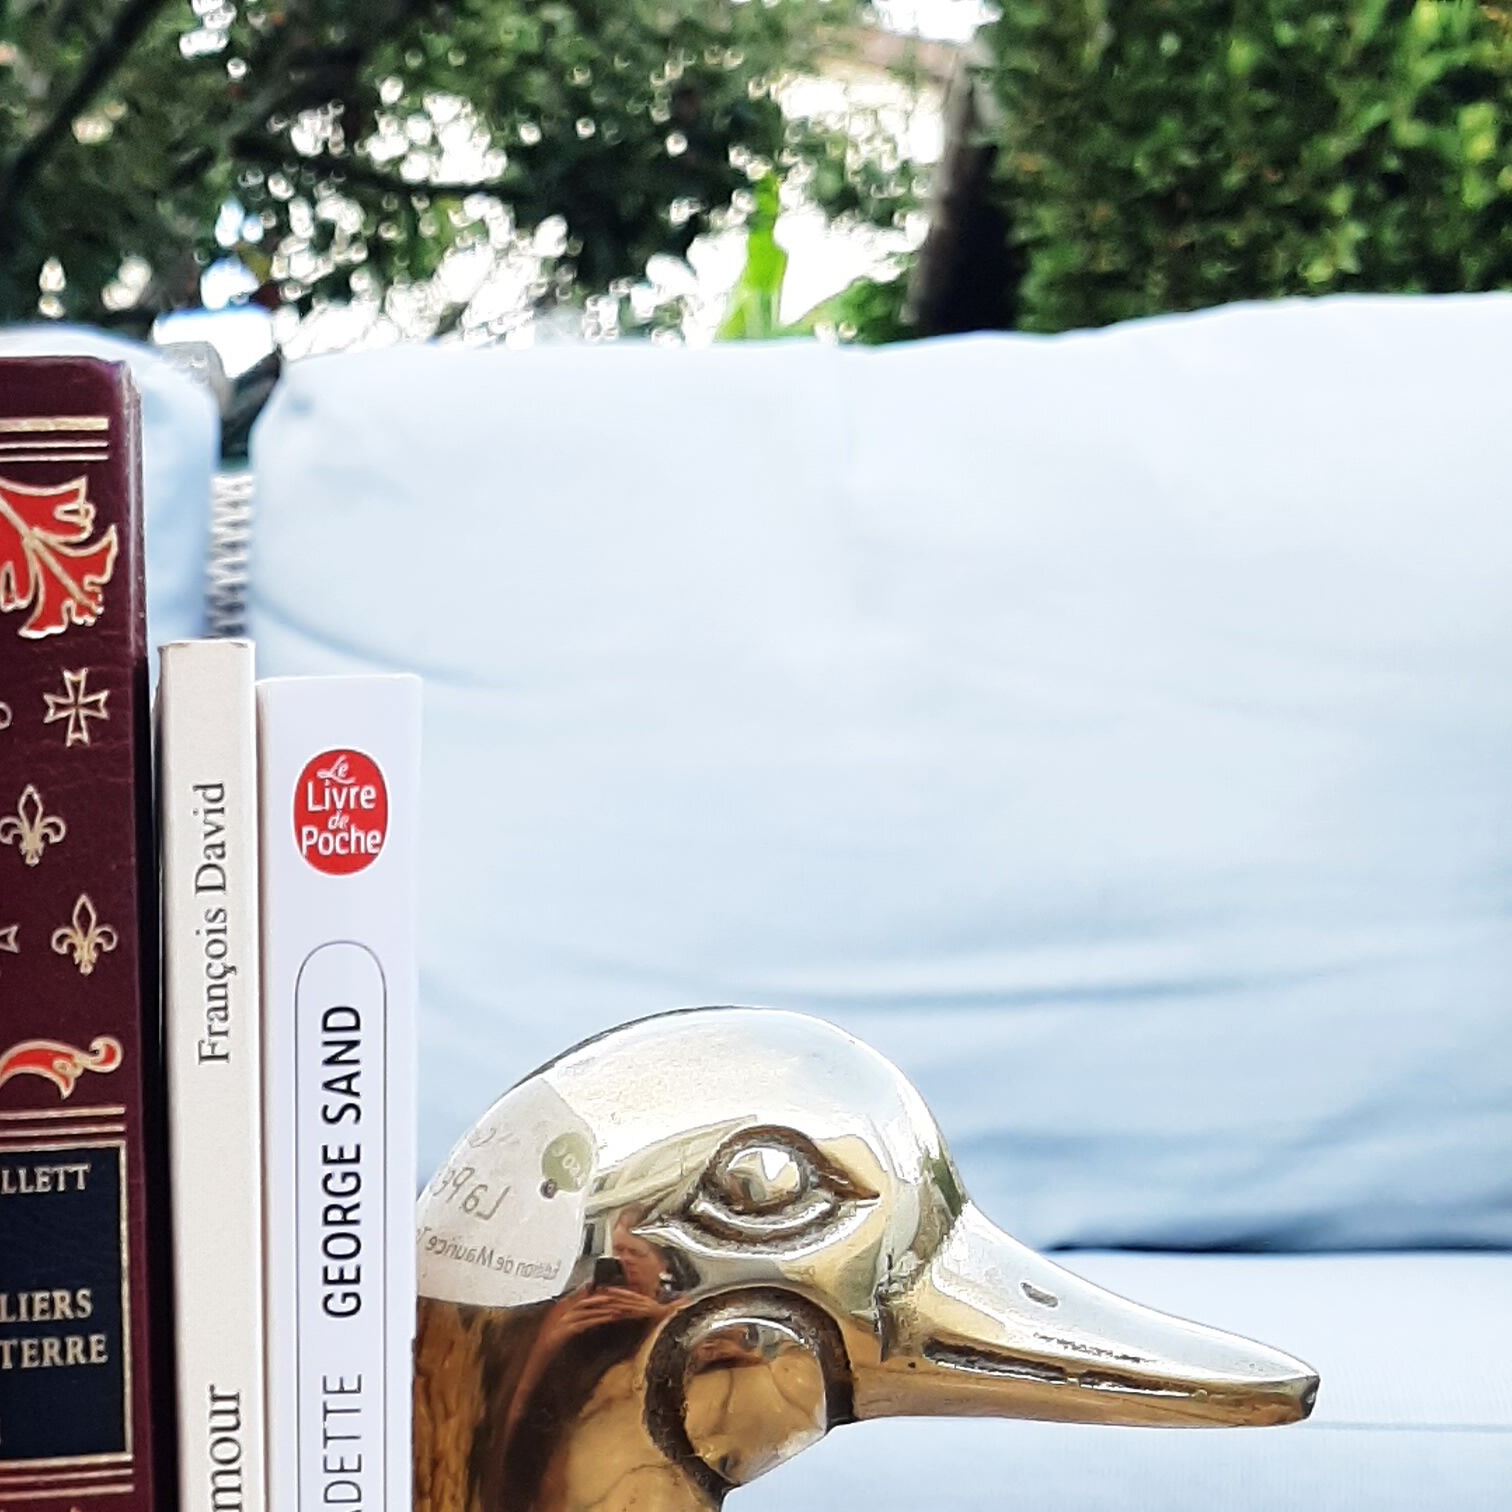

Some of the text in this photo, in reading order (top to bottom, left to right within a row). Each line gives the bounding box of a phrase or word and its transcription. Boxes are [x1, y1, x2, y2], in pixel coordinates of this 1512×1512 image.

[316, 754, 357, 784] Le
[307, 779, 377, 811] Livre
[328, 808, 350, 830] de
[301, 823, 382, 856] Poche
[192, 782, 237, 1064] François David
[321, 1005, 363, 1319] GEORGE SAND
